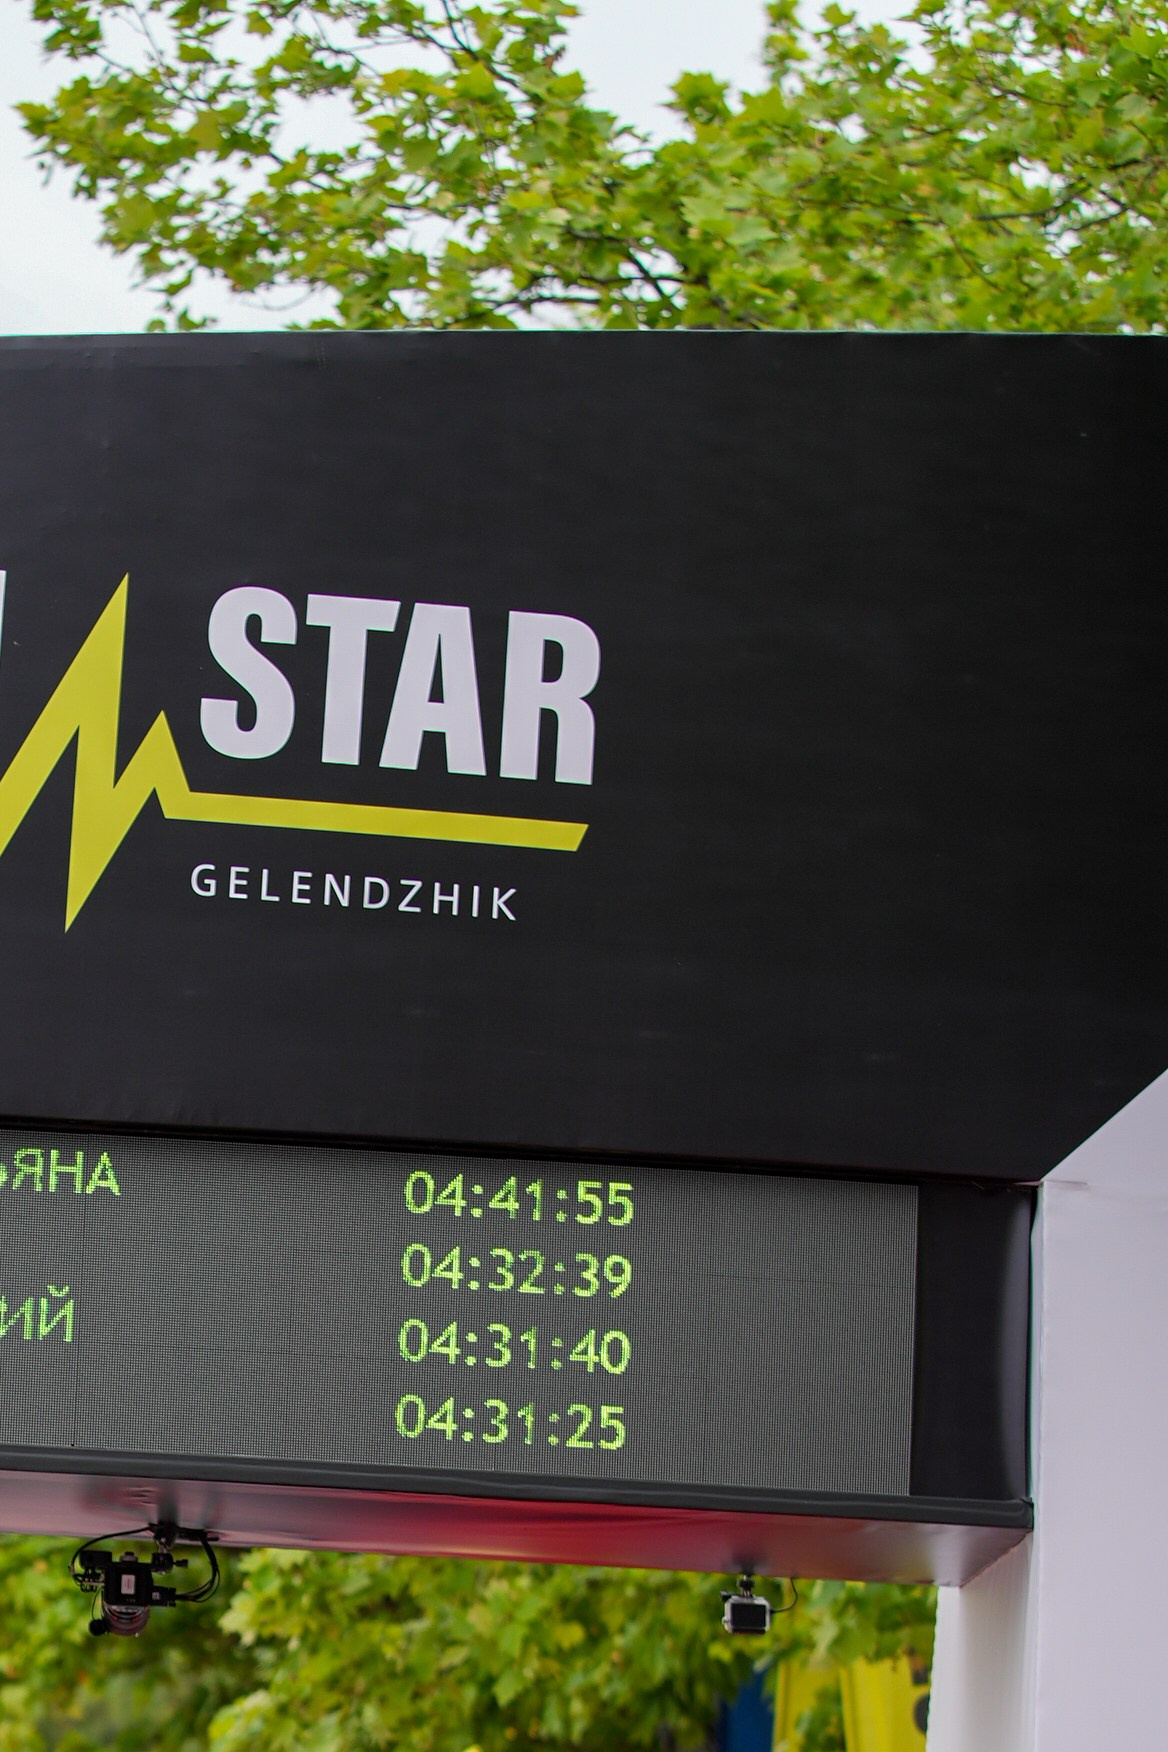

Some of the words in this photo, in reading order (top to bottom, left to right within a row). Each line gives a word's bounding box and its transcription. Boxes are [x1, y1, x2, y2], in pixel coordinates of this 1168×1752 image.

[200, 585, 601, 786] STAR
[190, 862, 518, 922] GELENDZHIK
[404, 1170, 635, 1226] 04:41:55
[401, 1242, 633, 1298] 04:32:39
[397, 1318, 631, 1375] 04:31:40
[394, 1393, 627, 1451] 04:31:25
